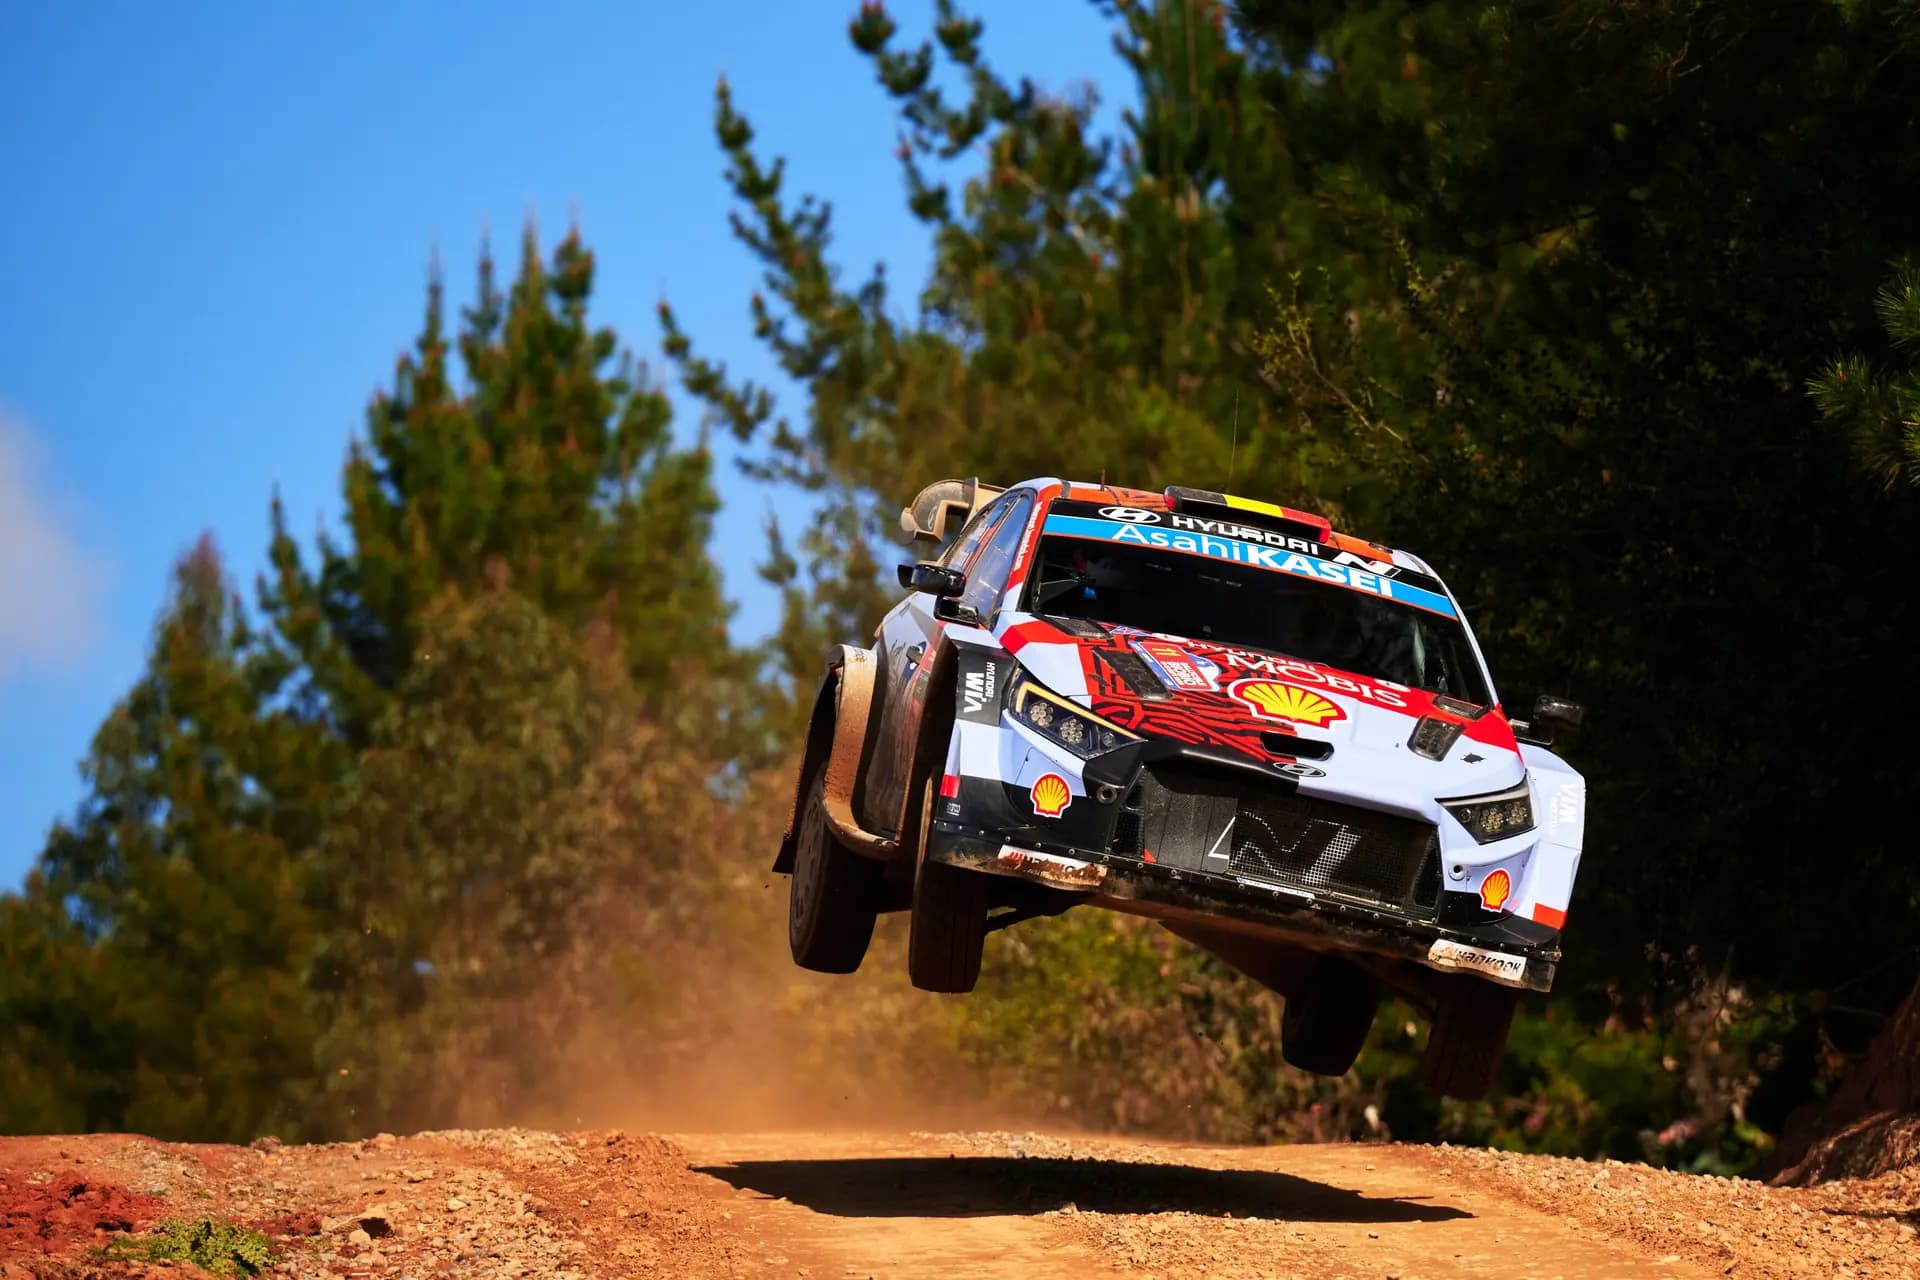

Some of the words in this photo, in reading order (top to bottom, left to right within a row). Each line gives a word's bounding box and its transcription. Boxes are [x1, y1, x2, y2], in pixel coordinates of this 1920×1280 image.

[1172, 515, 1319, 555] HYUNDAI
[985, 661, 996, 698] HYUNDAI
[1225, 653, 1408, 708] MOBIS
